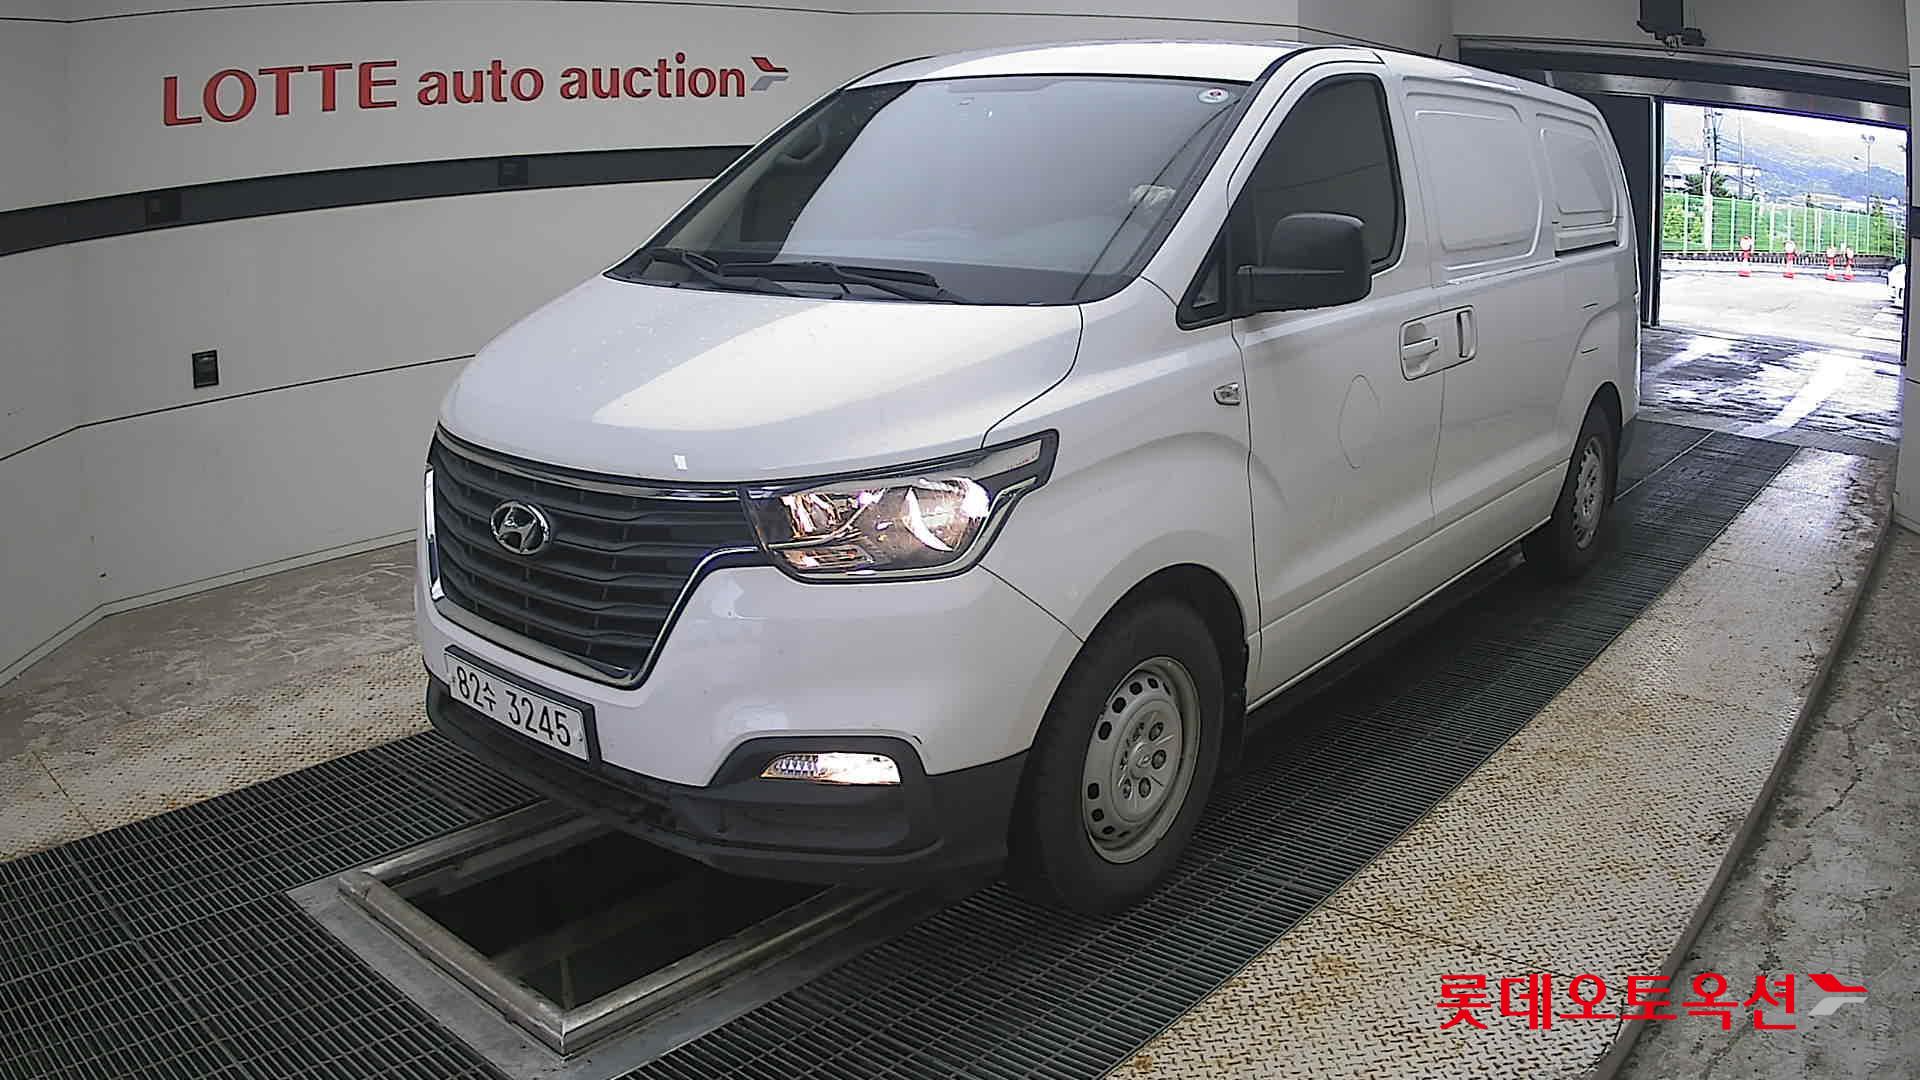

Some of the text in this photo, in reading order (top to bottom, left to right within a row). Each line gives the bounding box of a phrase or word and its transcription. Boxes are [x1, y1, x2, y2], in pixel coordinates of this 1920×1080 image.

[163, 53, 746, 127] LOTTE auto auction
[457, 666, 571, 747] 82수 3245
